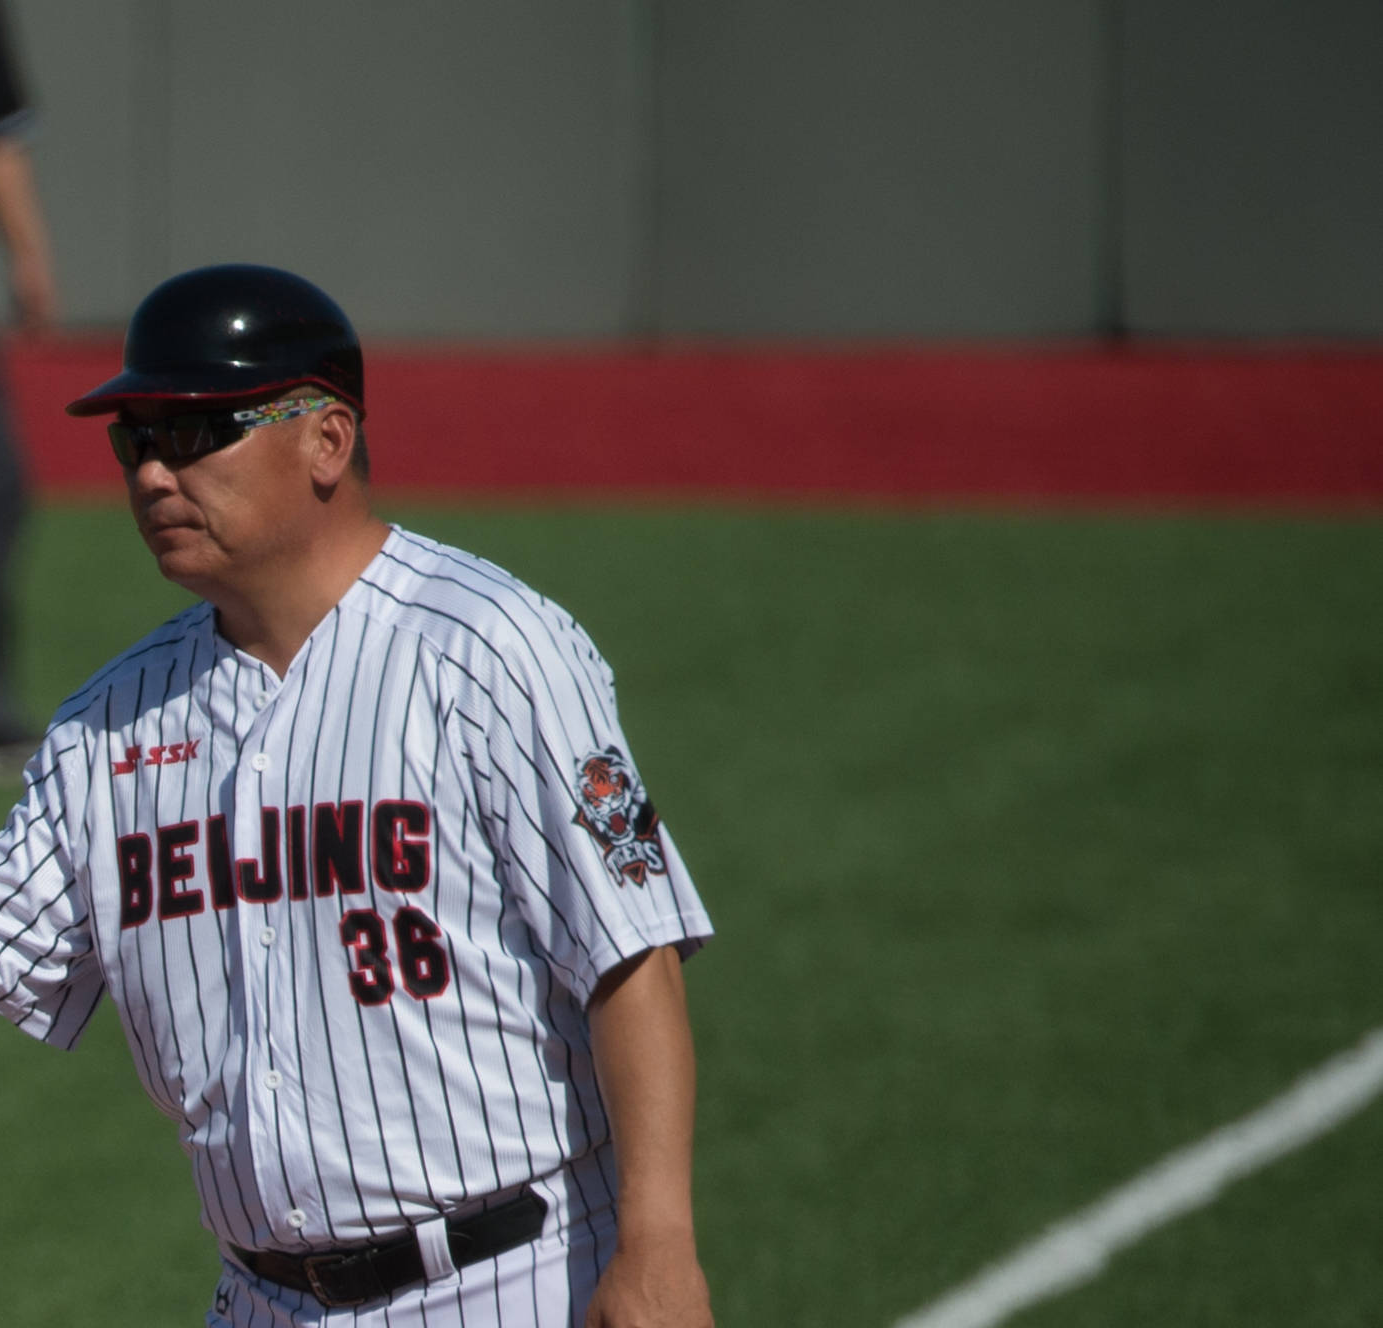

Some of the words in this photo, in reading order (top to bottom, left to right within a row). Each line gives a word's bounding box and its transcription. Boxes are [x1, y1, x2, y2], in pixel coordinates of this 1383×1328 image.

[144, 738, 202, 766] SSK
[116, 799, 431, 931] BEIJING
[339, 905, 451, 1007] 36
